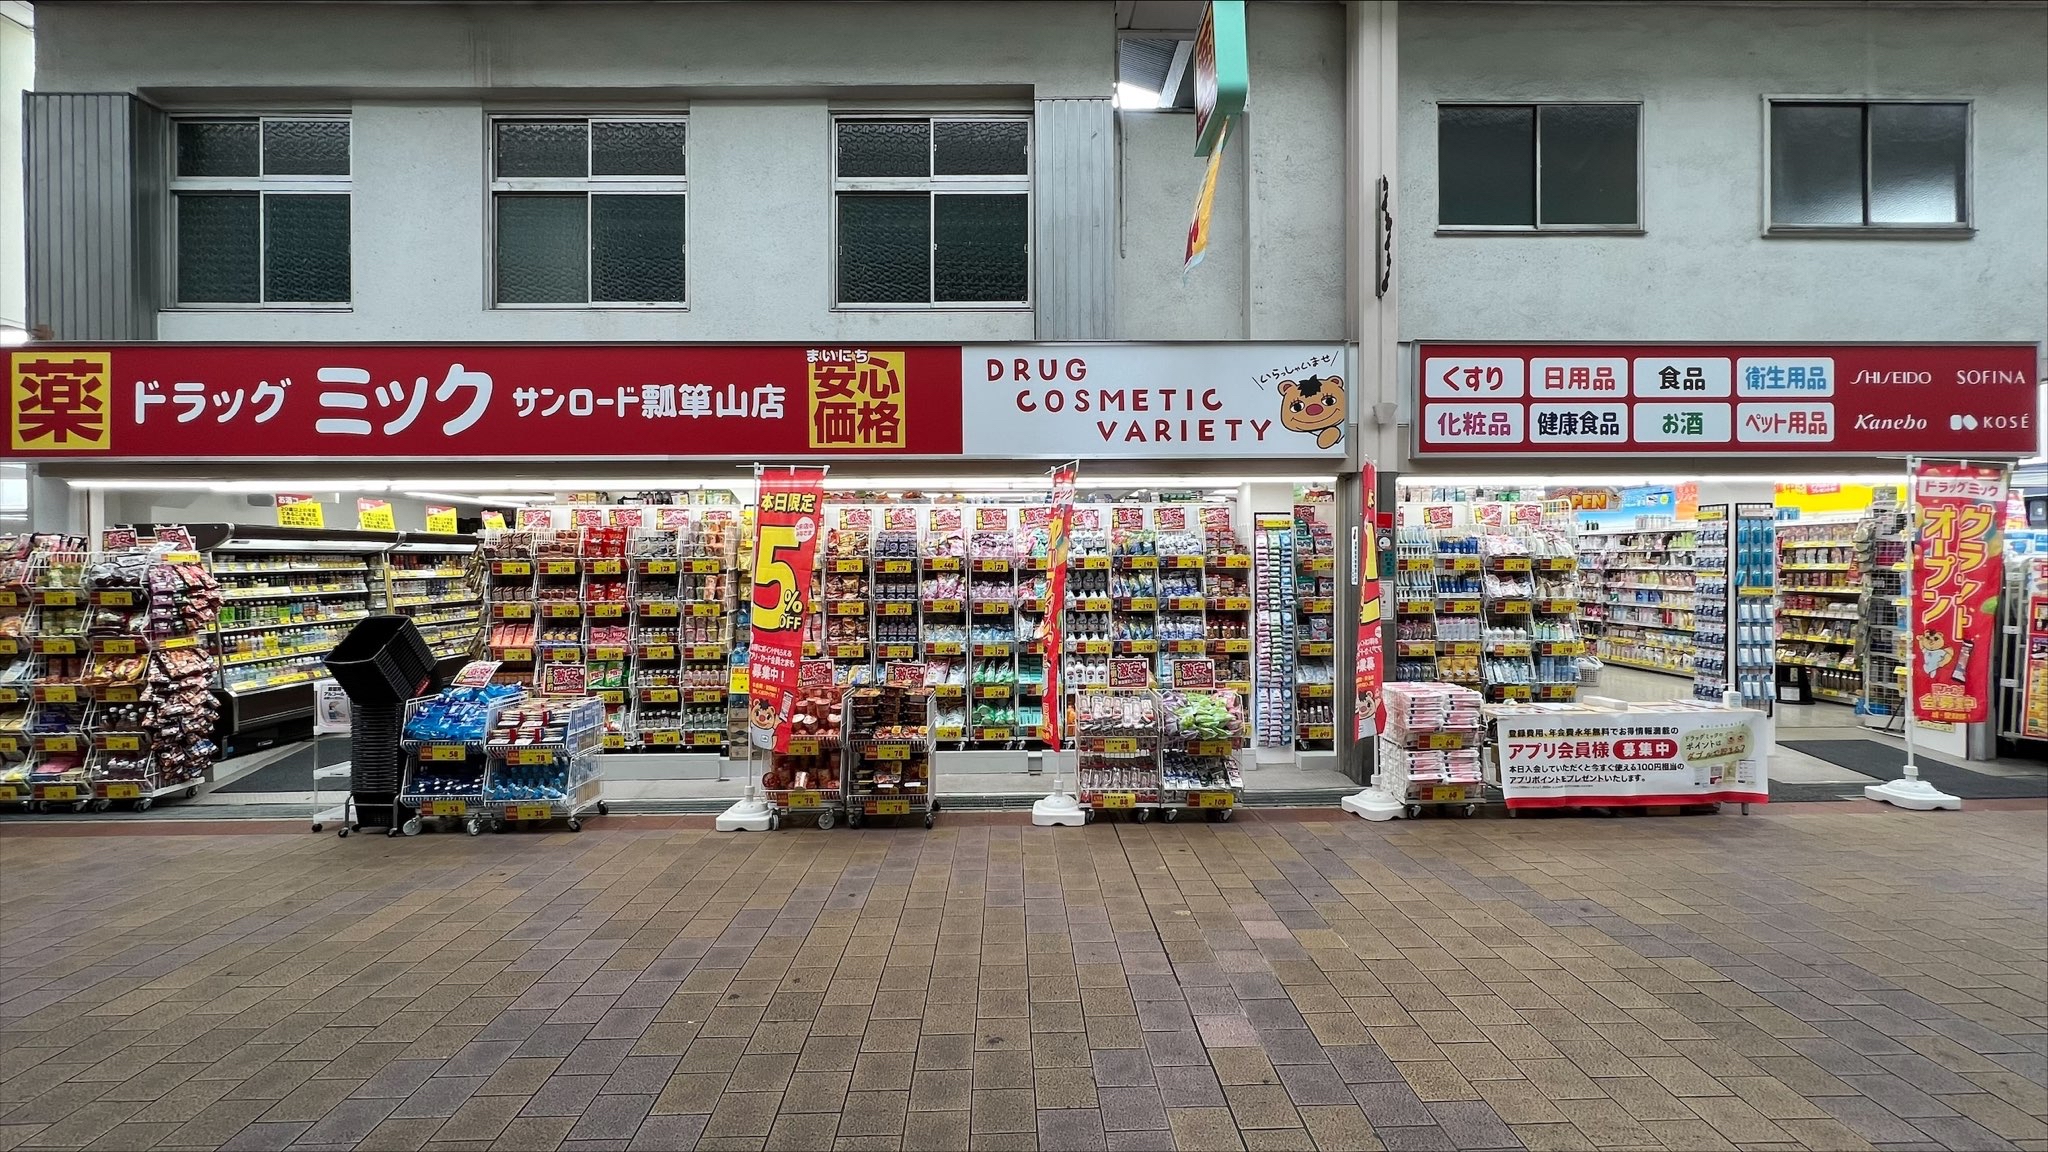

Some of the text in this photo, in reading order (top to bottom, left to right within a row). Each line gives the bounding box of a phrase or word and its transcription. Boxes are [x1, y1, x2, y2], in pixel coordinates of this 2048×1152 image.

[806, 348, 869, 364] まいにち
[814, 358, 901, 399] 安心
[986, 358, 1088, 382] DRUG
[1259, 354, 1332, 385] いらっしゃいませ
[1442, 366, 1504, 391] くすり
[1545, 366, 1616, 391] 日用品
[1658, 365, 1706, 391] 食品
[1745, 366, 1826, 390] 衛生用品
[1850, 369, 1932, 385] SHISEIDO
[1956, 370, 2026, 384] SOFINA
[18, 359, 104, 443] 薬
[134, 363, 494, 437] ドラッグ ミック
[512, 384, 786, 419] サンロード瓢箪山店
[1016, 388, 1224, 413] COSMETIC
[814, 400, 901, 444] 価格
[1096, 419, 1272, 442] VARIETY
[1438, 411, 1511, 436] 化粧品
[1537, 411, 1619, 436] 健康食品
[1661, 411, 1703, 435] お酒
[1745, 411, 1828, 435] ペット用品
[1854, 413, 1928, 431] Kanebo
[1983, 412, 2029, 429] KOSÉ
[1926, 481, 1999, 497] ドラッグミック
[760, 492, 817, 513] 本日限定
[1922, 503, 1960, 625] オープン
[1953, 503, 1994, 642] グランド
[779, 613, 802, 632] OFF
[553, 667, 580, 685] 激安
[801, 662, 826, 680] 激安
[1117, 661, 1142, 680] 激安
[1181, 662, 1206, 680] 激安
[1508, 741, 1670, 760] アプリ会員様 募集中
